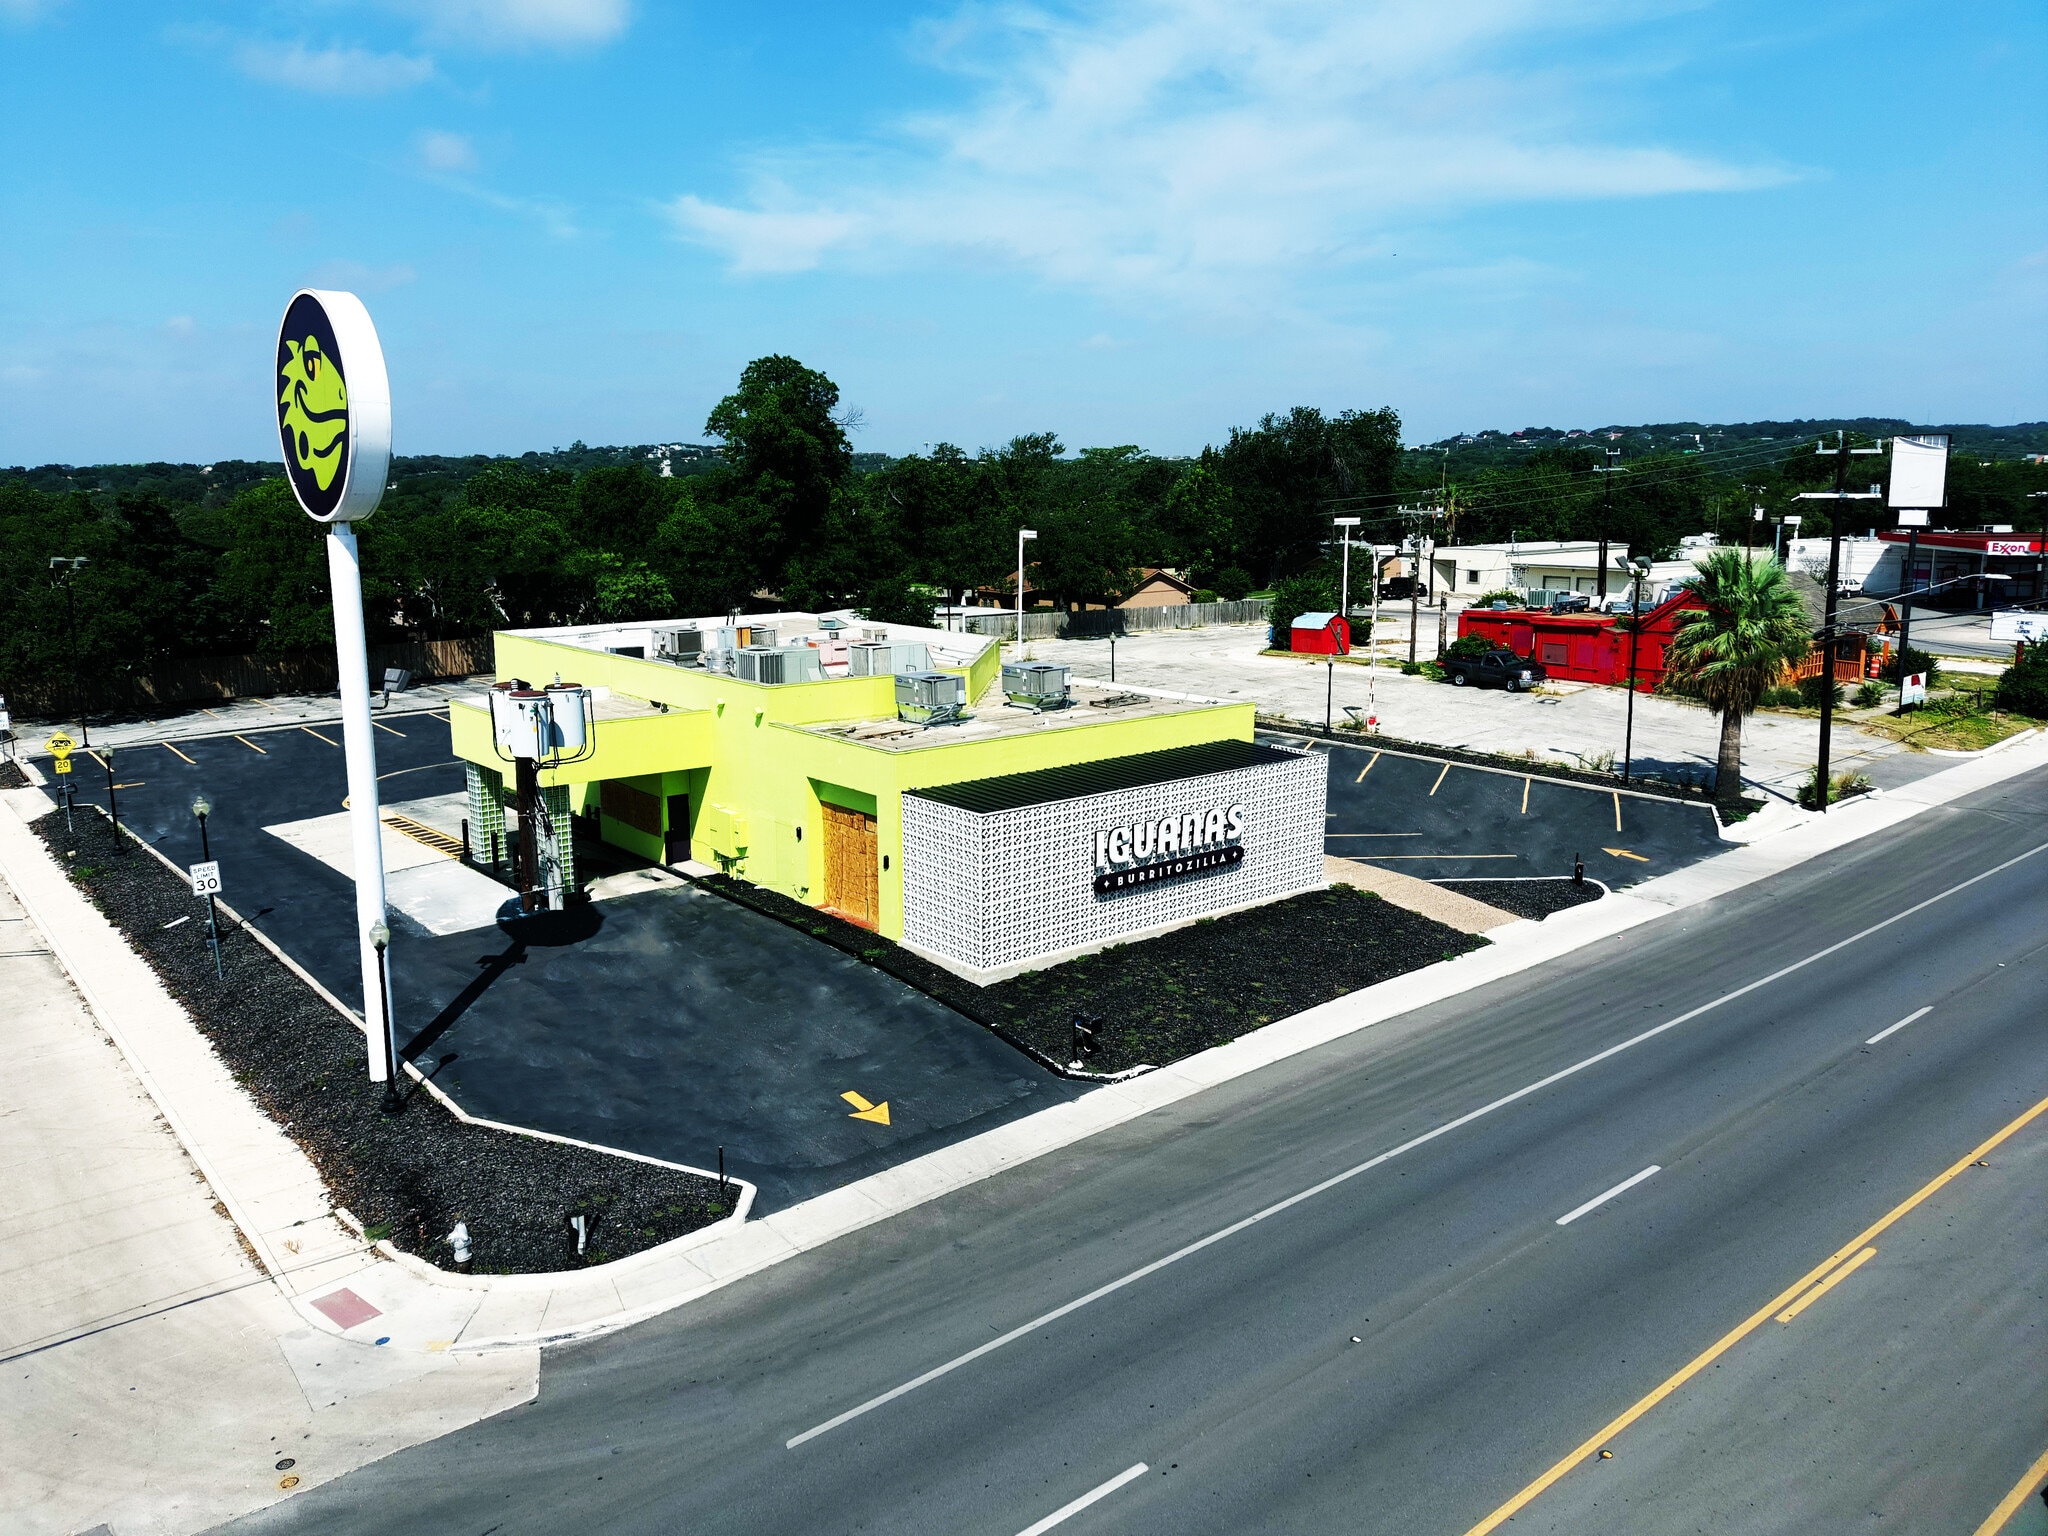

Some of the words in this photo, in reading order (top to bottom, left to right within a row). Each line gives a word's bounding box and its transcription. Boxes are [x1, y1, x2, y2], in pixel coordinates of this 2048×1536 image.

[1992, 543, 2025, 554] Exxon
[1095, 803, 1243, 868] IGUANAS
[1117, 853, 1226, 886] BURRITOZILLA
[197, 878, 217, 891] 30
